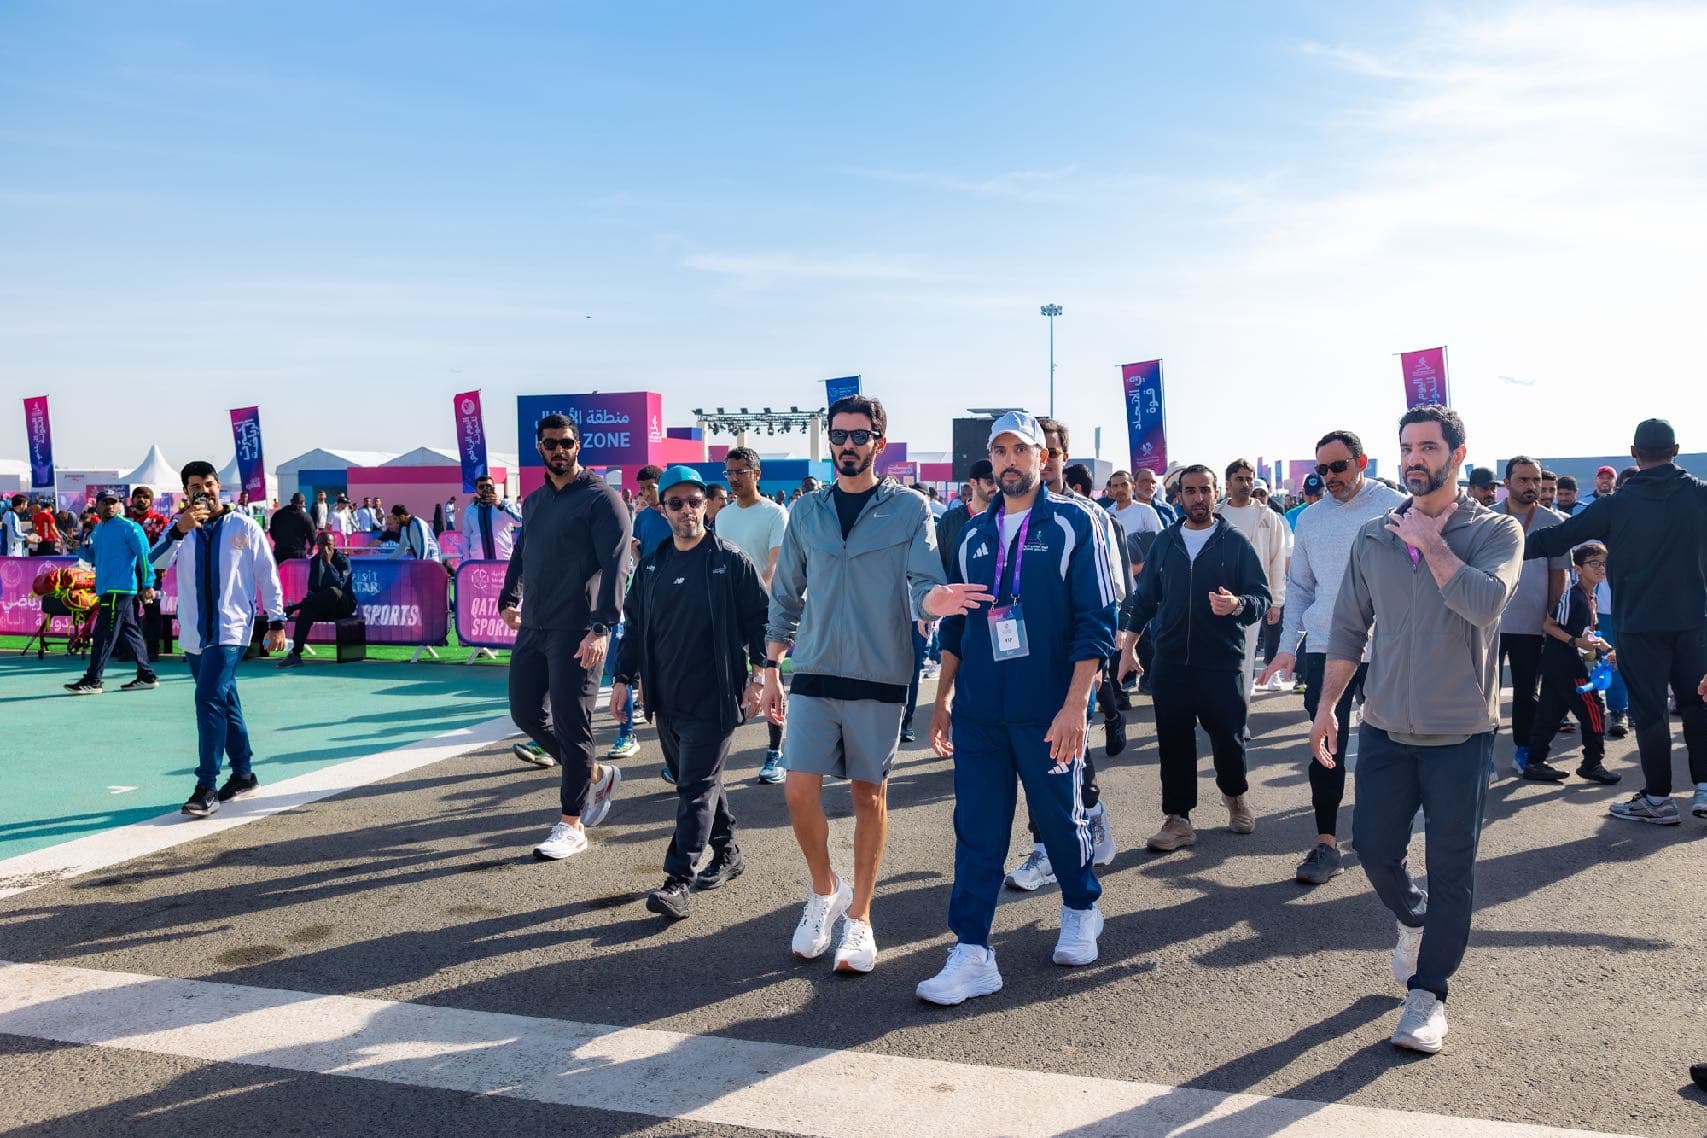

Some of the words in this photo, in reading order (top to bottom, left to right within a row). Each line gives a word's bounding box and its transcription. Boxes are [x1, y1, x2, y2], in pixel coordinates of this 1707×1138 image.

[1143, 388, 1159, 414] قوة
[586, 409, 629, 424] منطقة
[583, 433, 630, 448] ZONE
[362, 604, 419, 626] SPORTS
[471, 598, 500, 618] QATA
